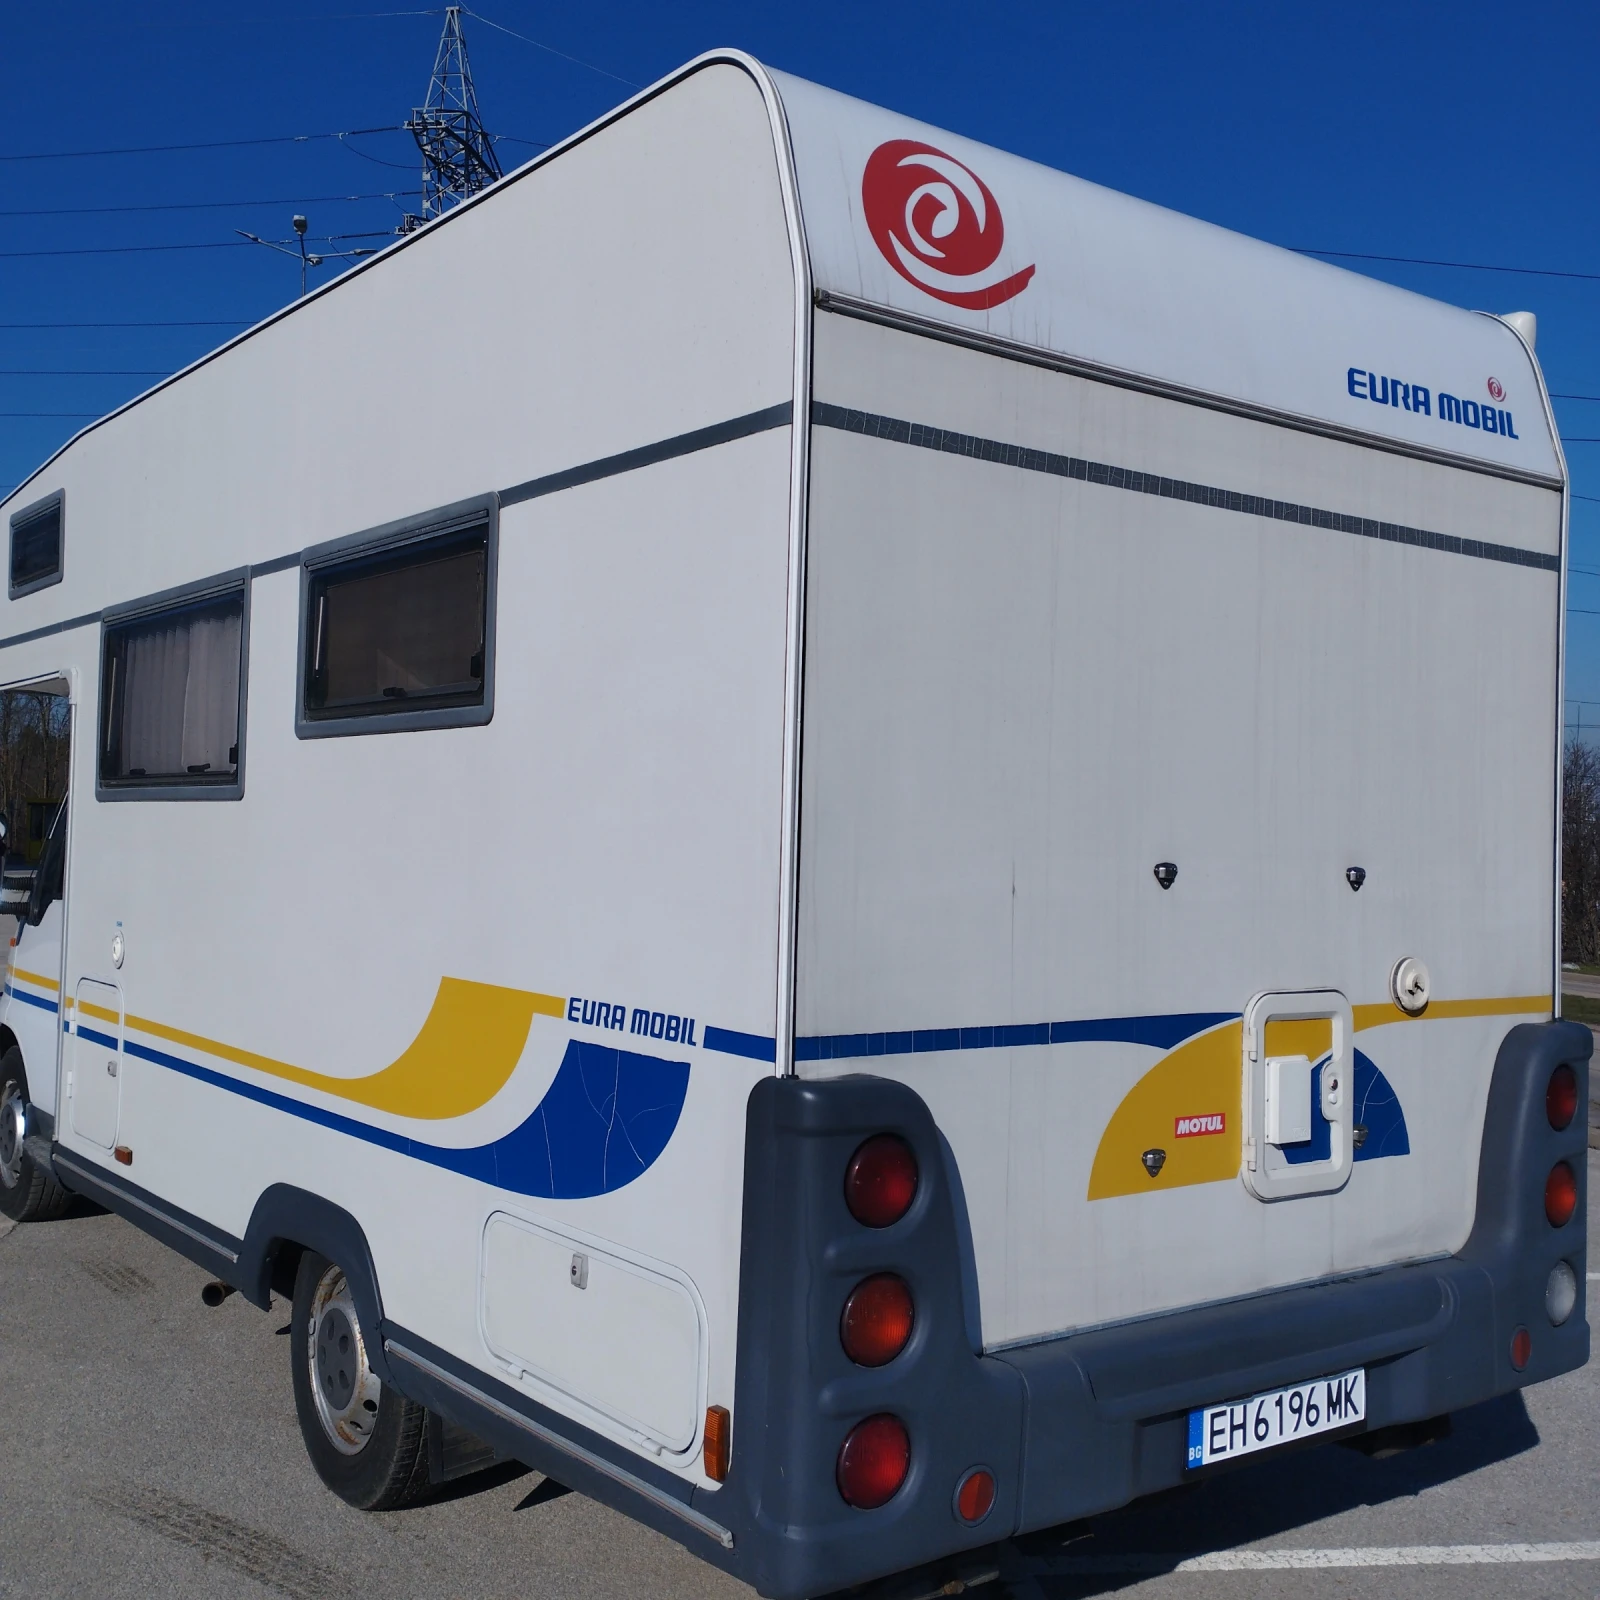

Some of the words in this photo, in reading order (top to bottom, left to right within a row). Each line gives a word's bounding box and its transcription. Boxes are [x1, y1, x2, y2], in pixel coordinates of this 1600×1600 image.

[1347, 367, 1431, 416] EURA
[1438, 392, 1519, 440] MOBIL
[567, 997, 626, 1031] EURA
[630, 1008, 696, 1046] MOBIL
[1177, 1116, 1223, 1134] MOTUL
[1188, 1446, 1202, 1461] BG
